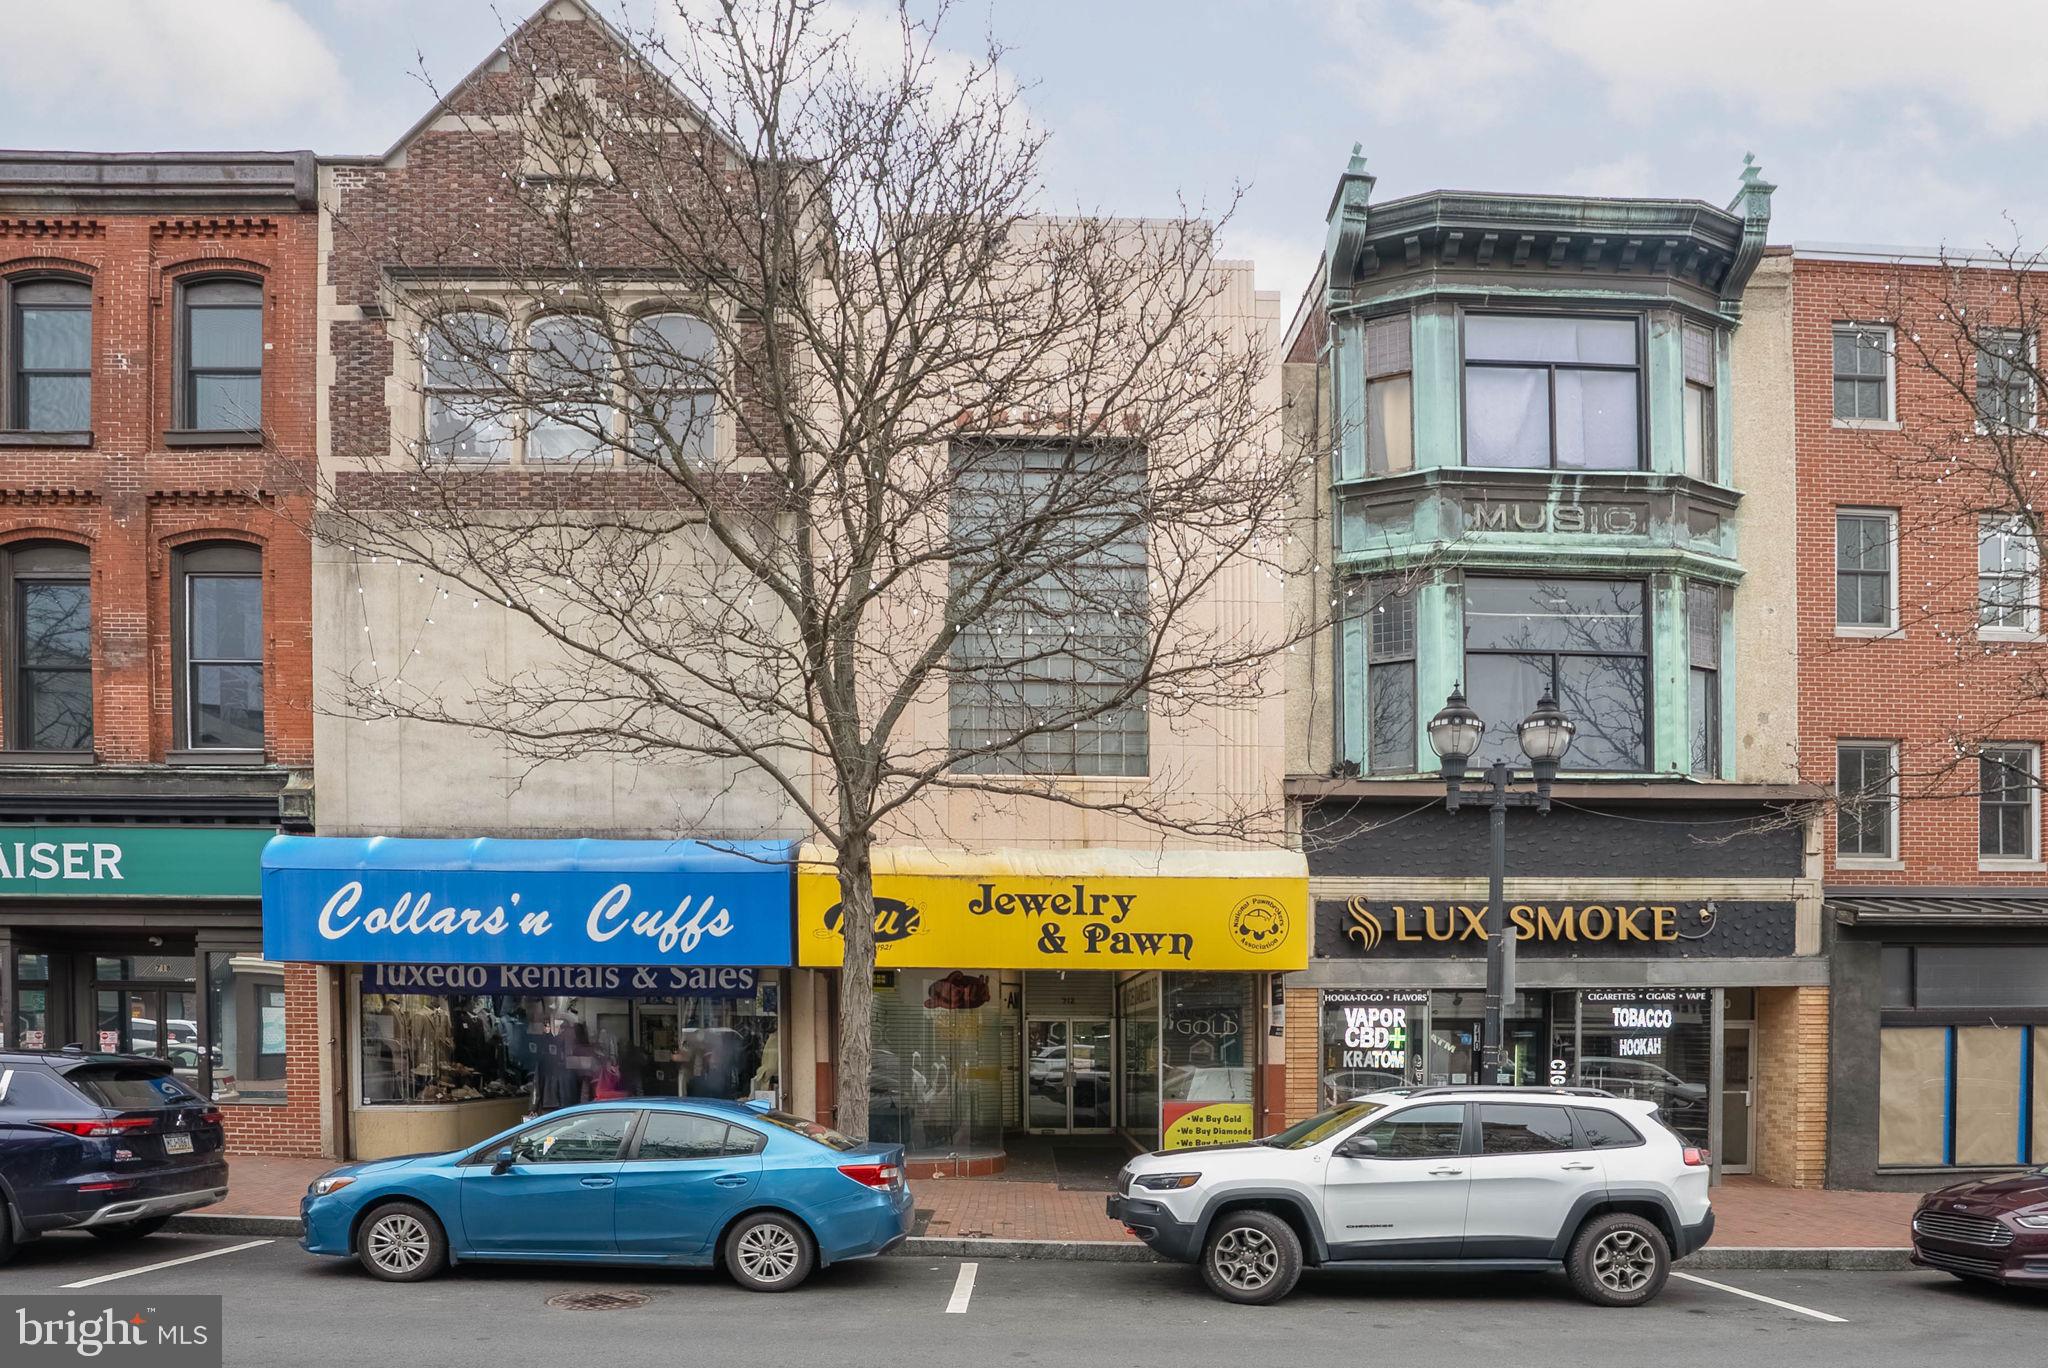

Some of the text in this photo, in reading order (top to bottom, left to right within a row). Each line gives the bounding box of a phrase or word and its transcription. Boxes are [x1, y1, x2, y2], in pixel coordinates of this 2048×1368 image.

[1474, 503, 1637, 534] MUSIC
[968, 884, 1137, 923] Jewelry
[587, 883, 734, 953] Cuffs
[1233, 901, 1249, 927] National
[1393, 905, 1680, 941] LUX SMOKE
[1037, 922, 1193, 960] & Pawn
[1241, 938, 1279, 949] Association
[500, 965, 620, 988] Rentals
[632, 966, 658, 988] &
[670, 966, 754, 989] Sales
[1324, 993, 1428, 1002] HOOKA-TO-GO FLAVORS
[1588, 992, 1706, 1000] CIGARETTES CIGARS VAPE
[1177, 1020, 1238, 1034] GOLD
[1343, 1007, 1407, 1028] VAPOR
[1612, 1007, 1673, 1029] TOBACCO
[1430, 1033, 1456, 1053] ATM
[1619, 1037, 1662, 1056] HOOKAH
[1342, 1050, 1405, 1069] KRATOM
[1206, 1115, 1221, 1124] Buy
[1181, 1127, 1252, 1136] We Buy Diamonds
